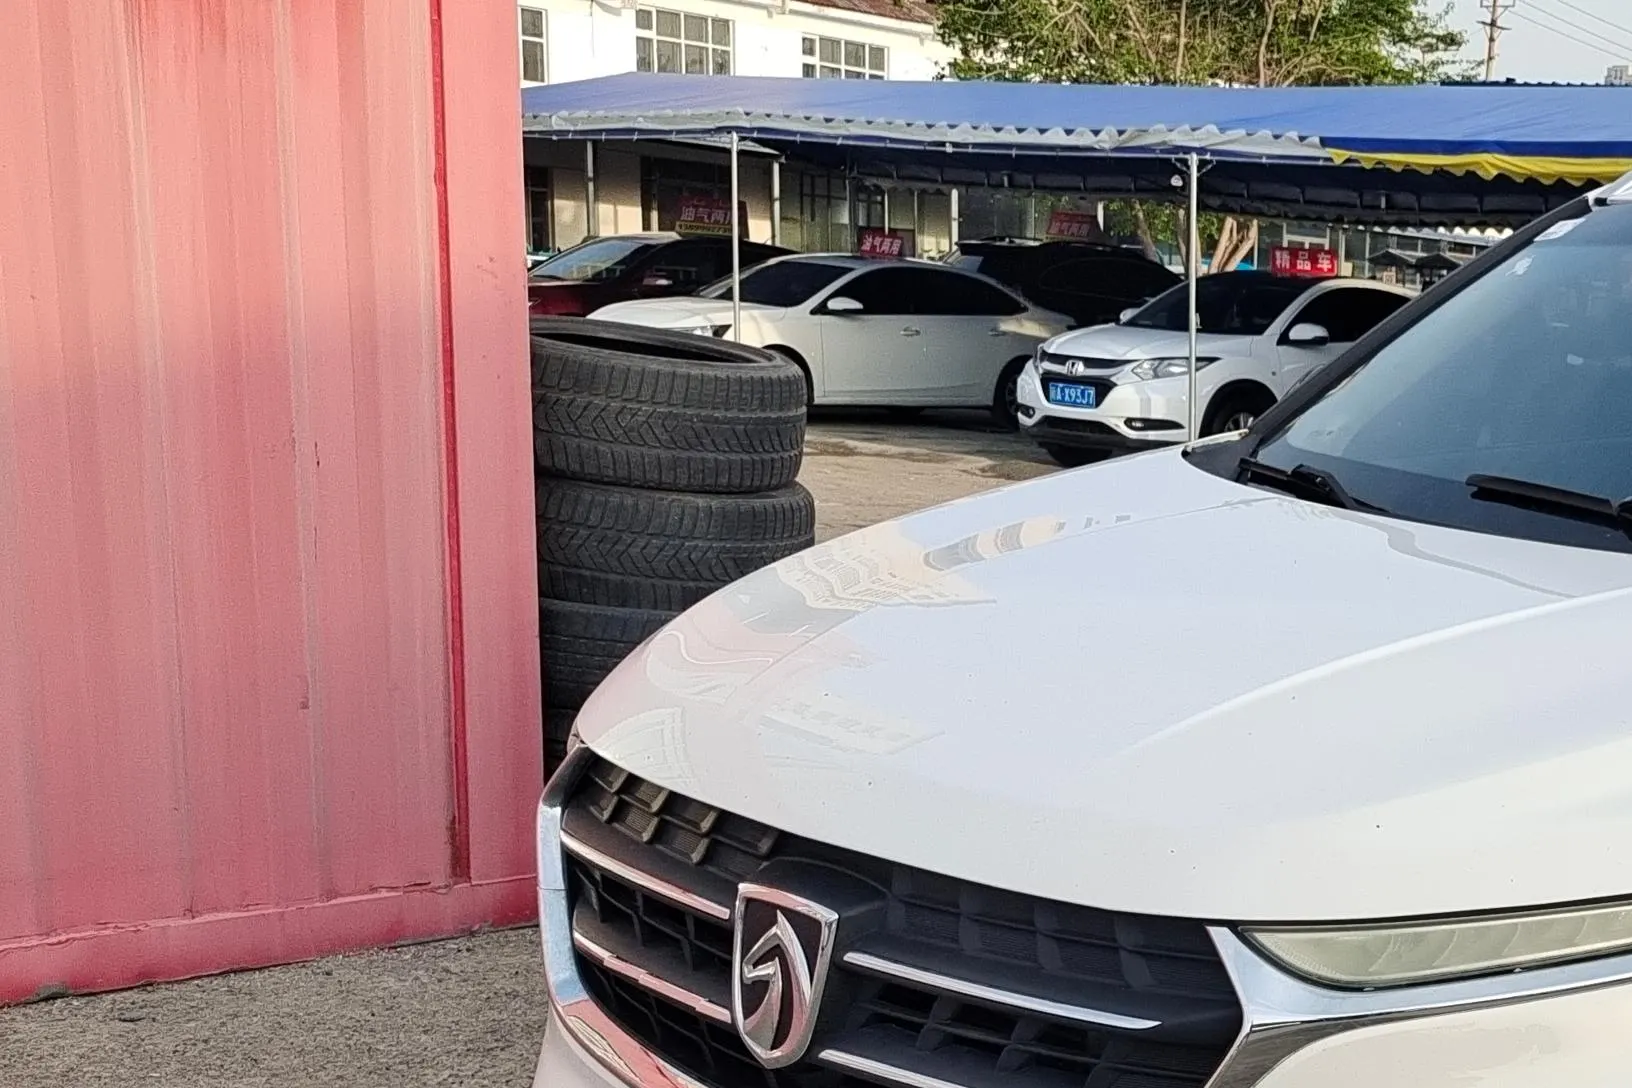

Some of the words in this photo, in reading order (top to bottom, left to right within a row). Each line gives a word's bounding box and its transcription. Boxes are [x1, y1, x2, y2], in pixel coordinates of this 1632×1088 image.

[680, 205, 733, 225] 油气两
[1275, 251, 1333, 273] 精品车
